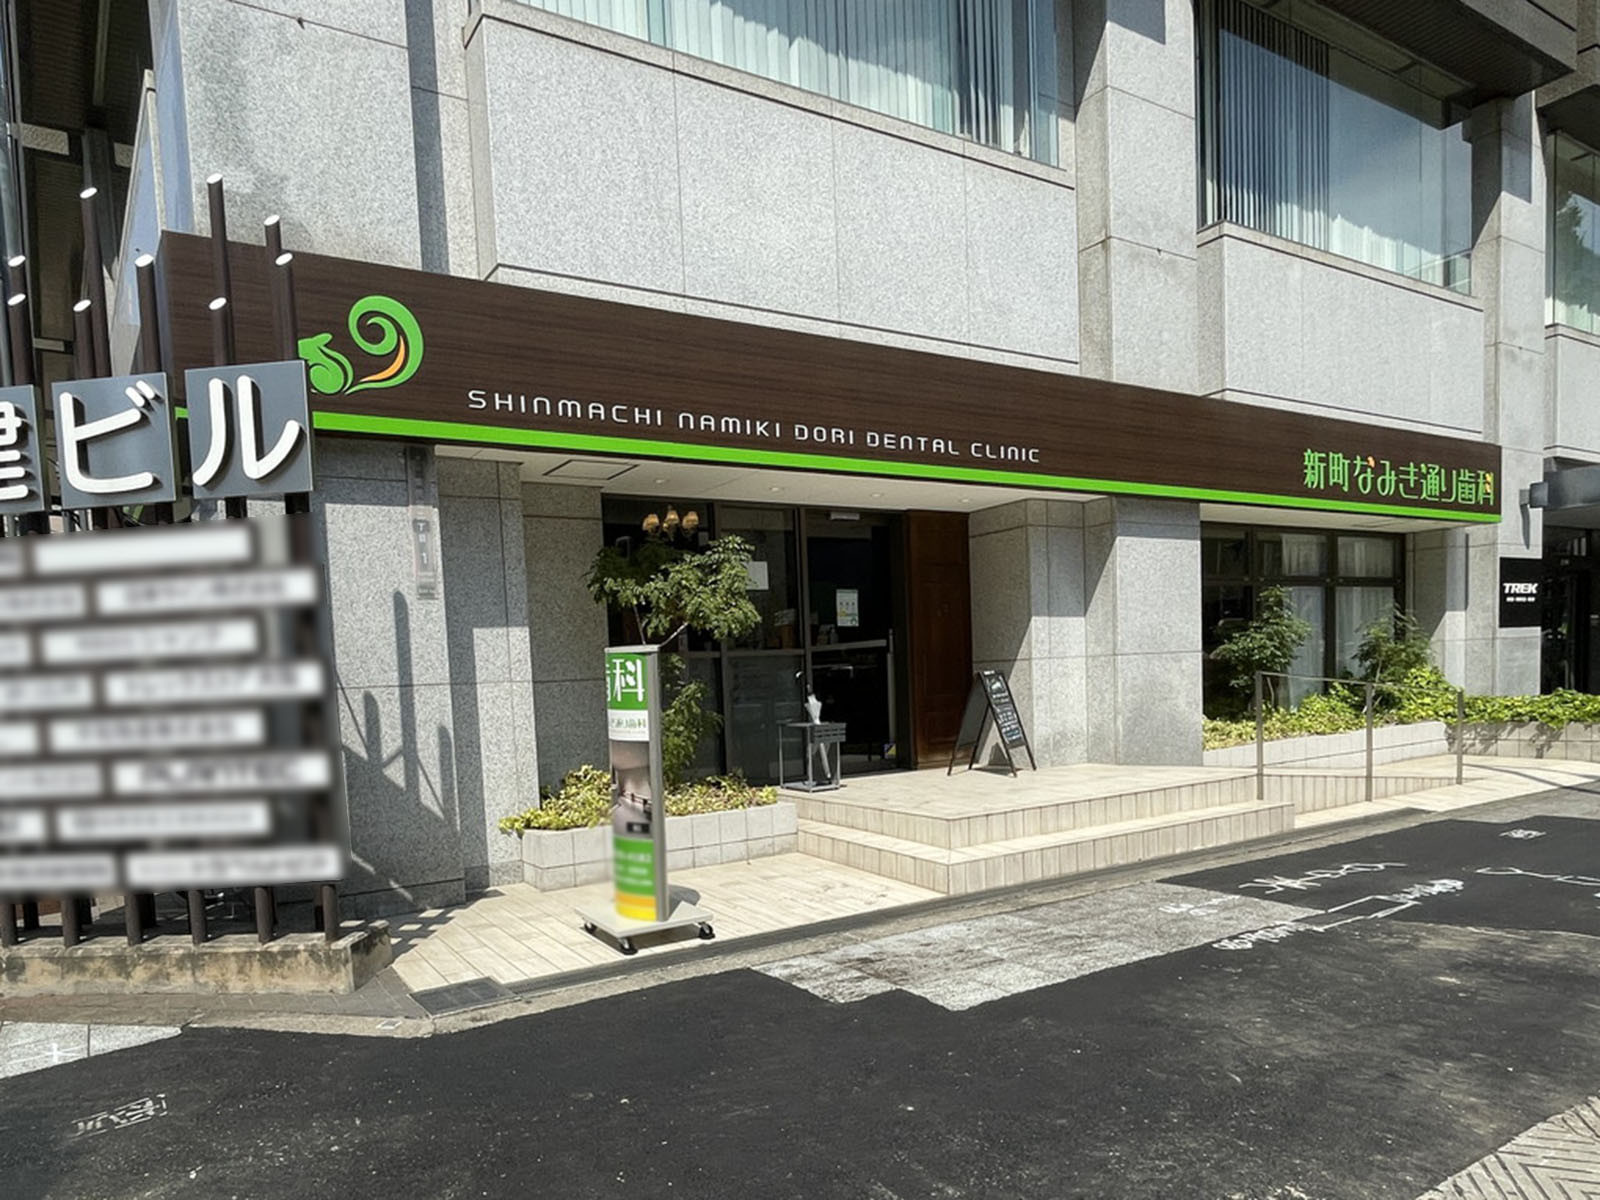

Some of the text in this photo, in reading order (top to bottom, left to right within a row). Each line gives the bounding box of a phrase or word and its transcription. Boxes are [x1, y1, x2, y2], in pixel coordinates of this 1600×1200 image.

[467, 389, 1040, 463] SHINMACHI NAMIKI DORI DENTAL CLINIC
[1303, 448, 1495, 506] 新町なみき通り歯科
[1503, 582, 1539, 594] TREK
[606, 658, 645, 702] 科
